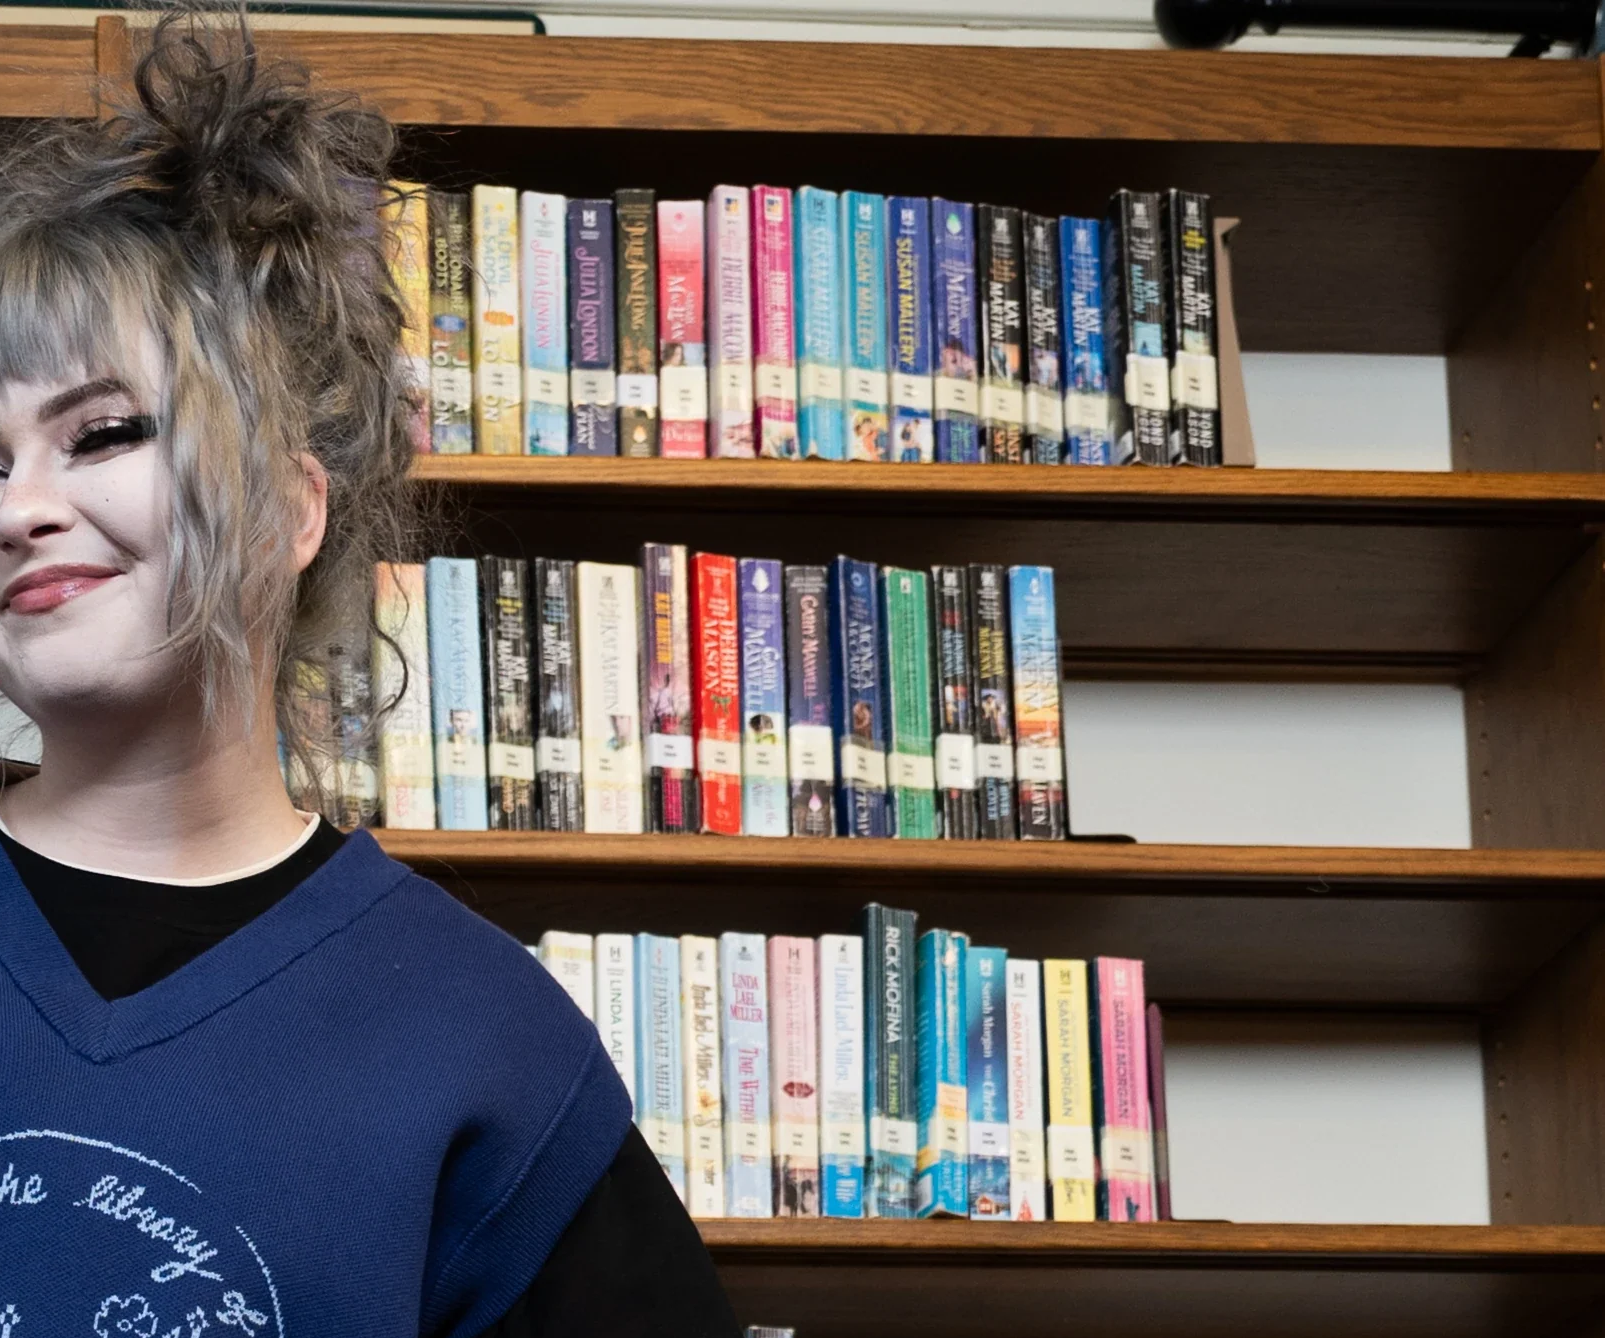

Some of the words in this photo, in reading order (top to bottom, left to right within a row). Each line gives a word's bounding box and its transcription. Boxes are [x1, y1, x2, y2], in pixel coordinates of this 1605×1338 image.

[575, 246, 597, 297] JULIA
[897, 238, 911, 289] SUSAN
[576, 299, 600, 362] LONDON
[899, 294, 914, 365] MALLERY
[1181, 276, 1196, 324] MARTIN
[1196, 293, 1210, 317] KAT
[704, 617, 721, 690] MASON
[720, 619, 737, 695] DEBBIE
[885, 924, 901, 969] RICK
[885, 970, 901, 1042] MOFINA
[1010, 1001, 1023, 1050] SARAH
[1013, 1055, 1025, 1120] MORGAN
[74, 1175, 223, 1283] library
